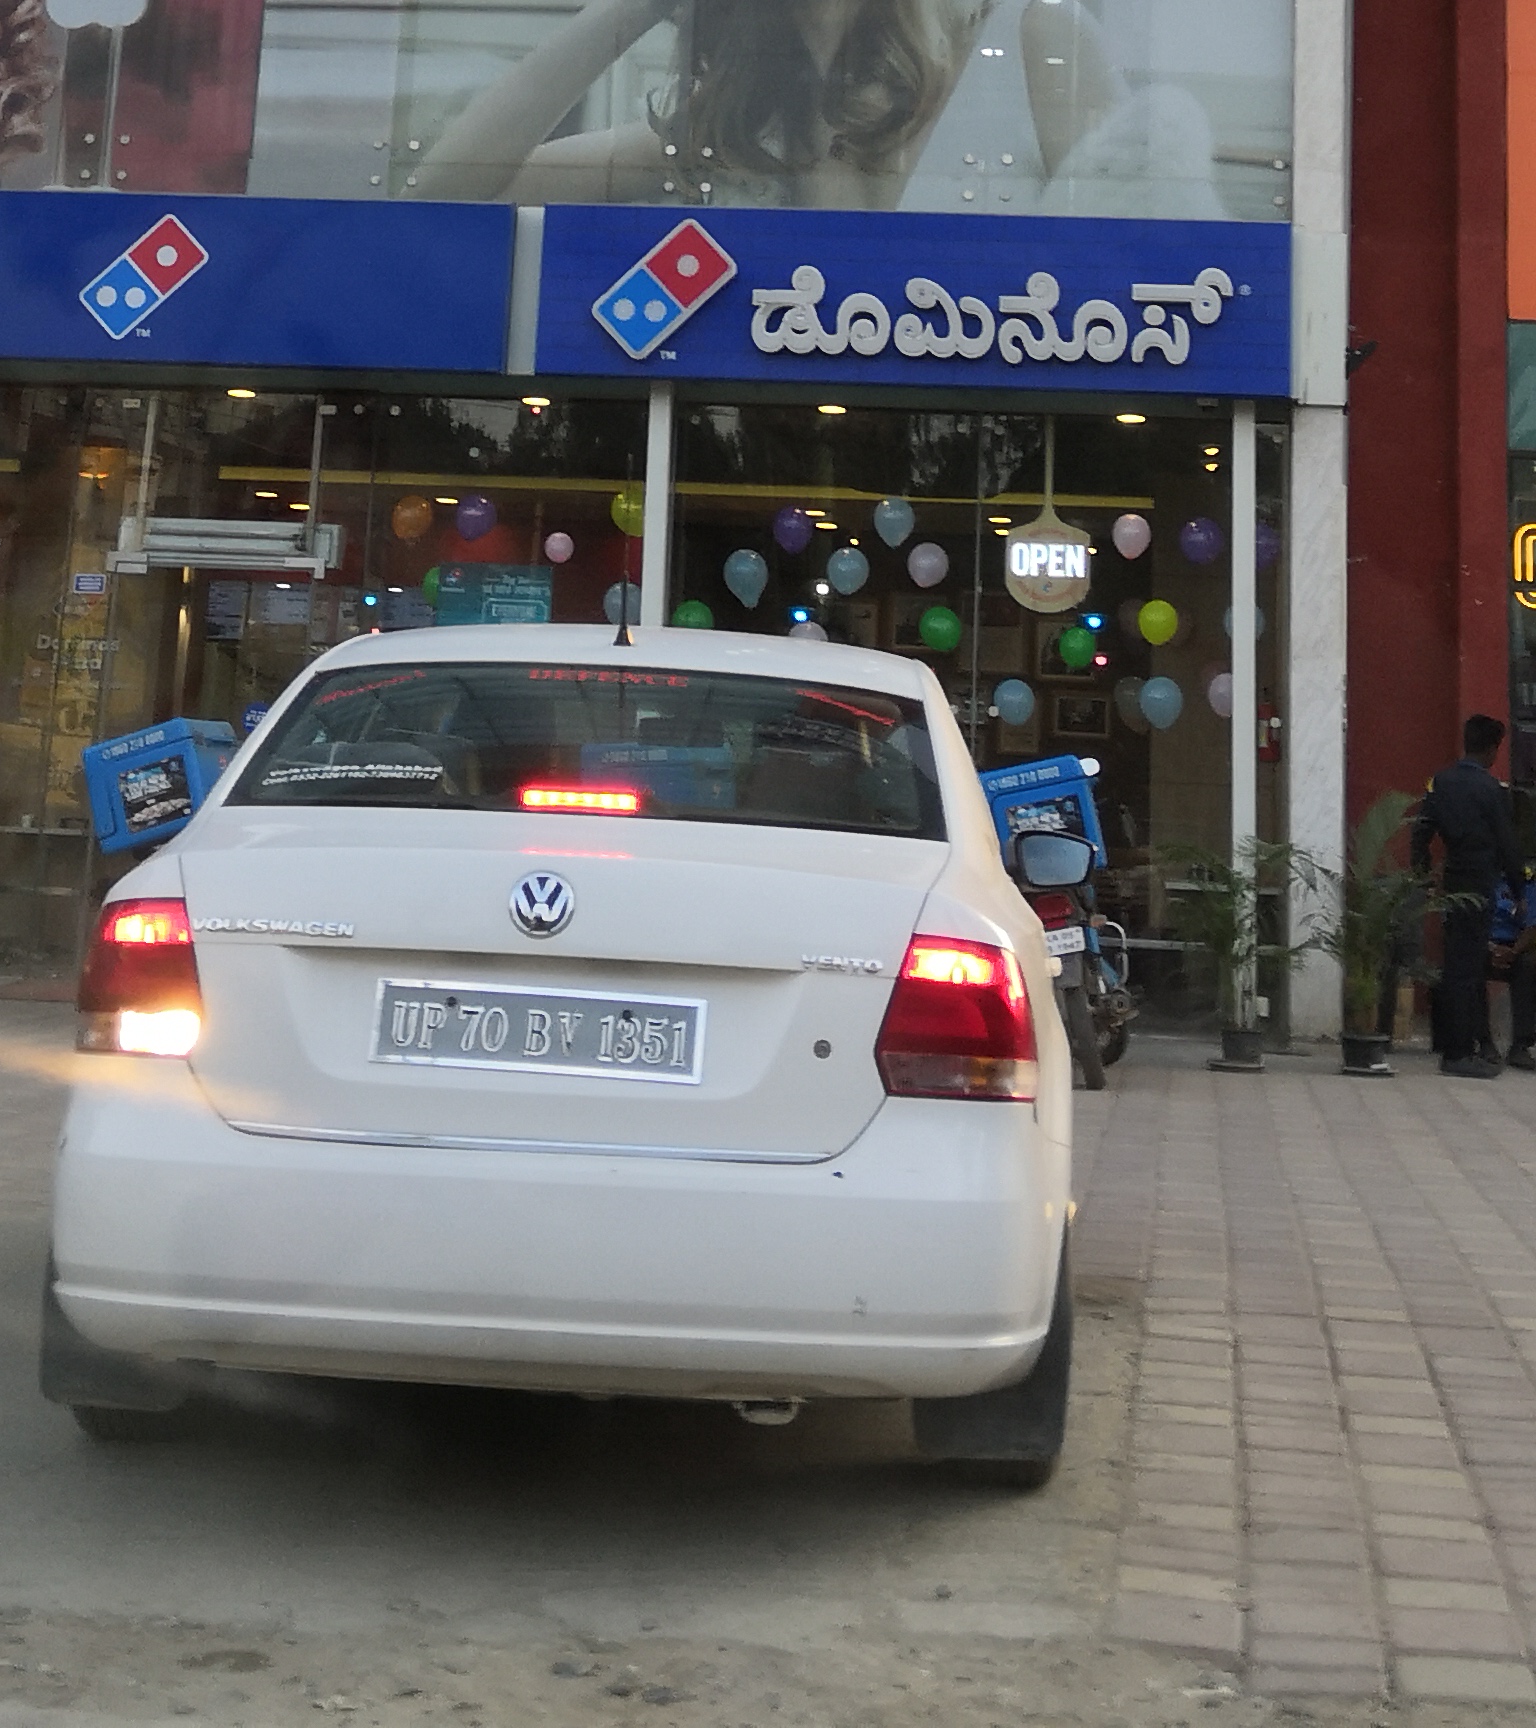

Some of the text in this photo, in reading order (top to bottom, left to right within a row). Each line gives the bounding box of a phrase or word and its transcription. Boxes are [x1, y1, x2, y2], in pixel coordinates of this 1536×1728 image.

[1011, 542, 1087, 579] OPEN
[192, 917, 355, 938] VOLKSWAGEN
[800, 952, 885, 975] VENTO
[392, 1000, 446, 1051] UP
[458, 1006, 509, 1054] 70
[596, 1015, 691, 1069] 1351
